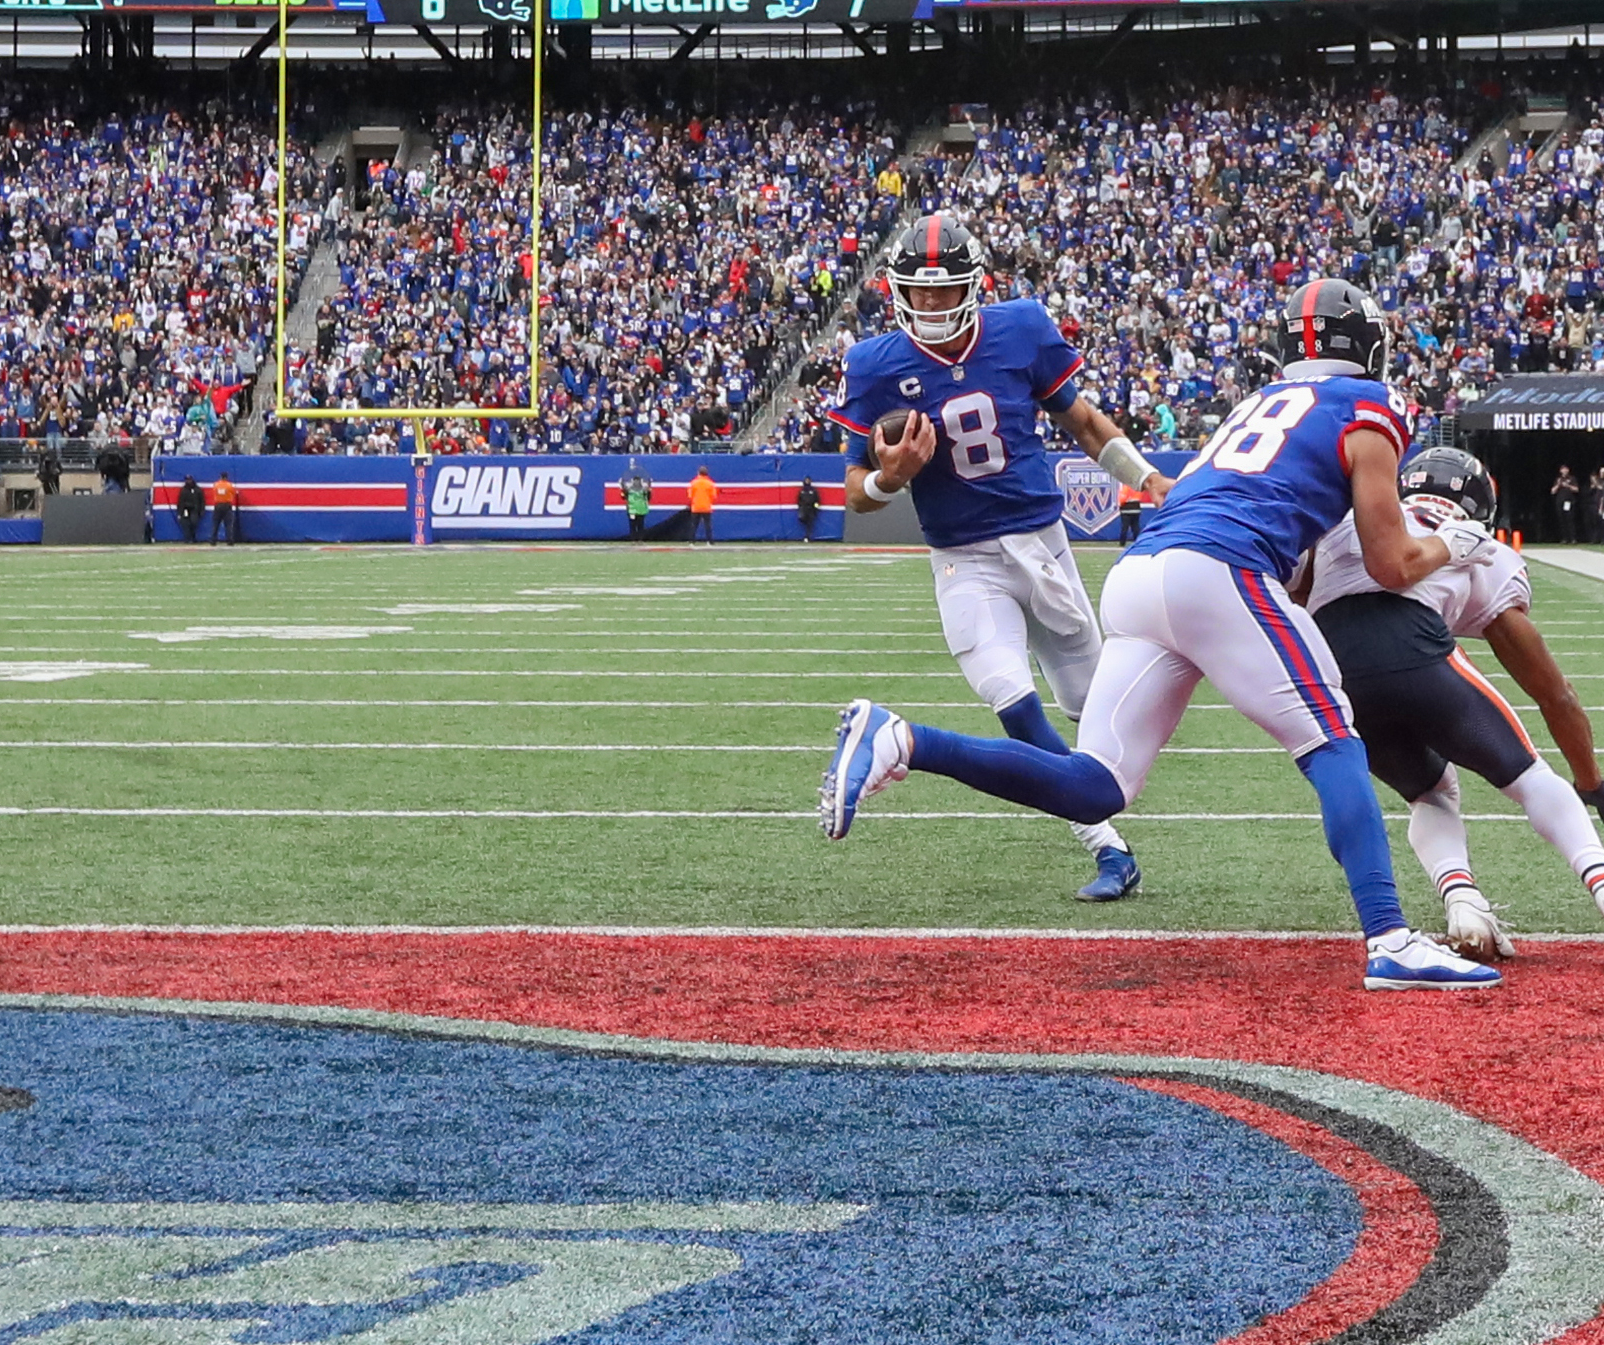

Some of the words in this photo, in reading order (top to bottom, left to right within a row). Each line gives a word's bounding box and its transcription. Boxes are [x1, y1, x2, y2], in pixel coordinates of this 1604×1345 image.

[1494, 413, 1550, 430] METLIFE
[940, 390, 1008, 481] 8
[1066, 471, 1089, 485] SUPER
[1091, 471, 1112, 485] BOWL
[431, 466, 582, 515] GIANTS
[1067, 486, 1113, 510] XXV
